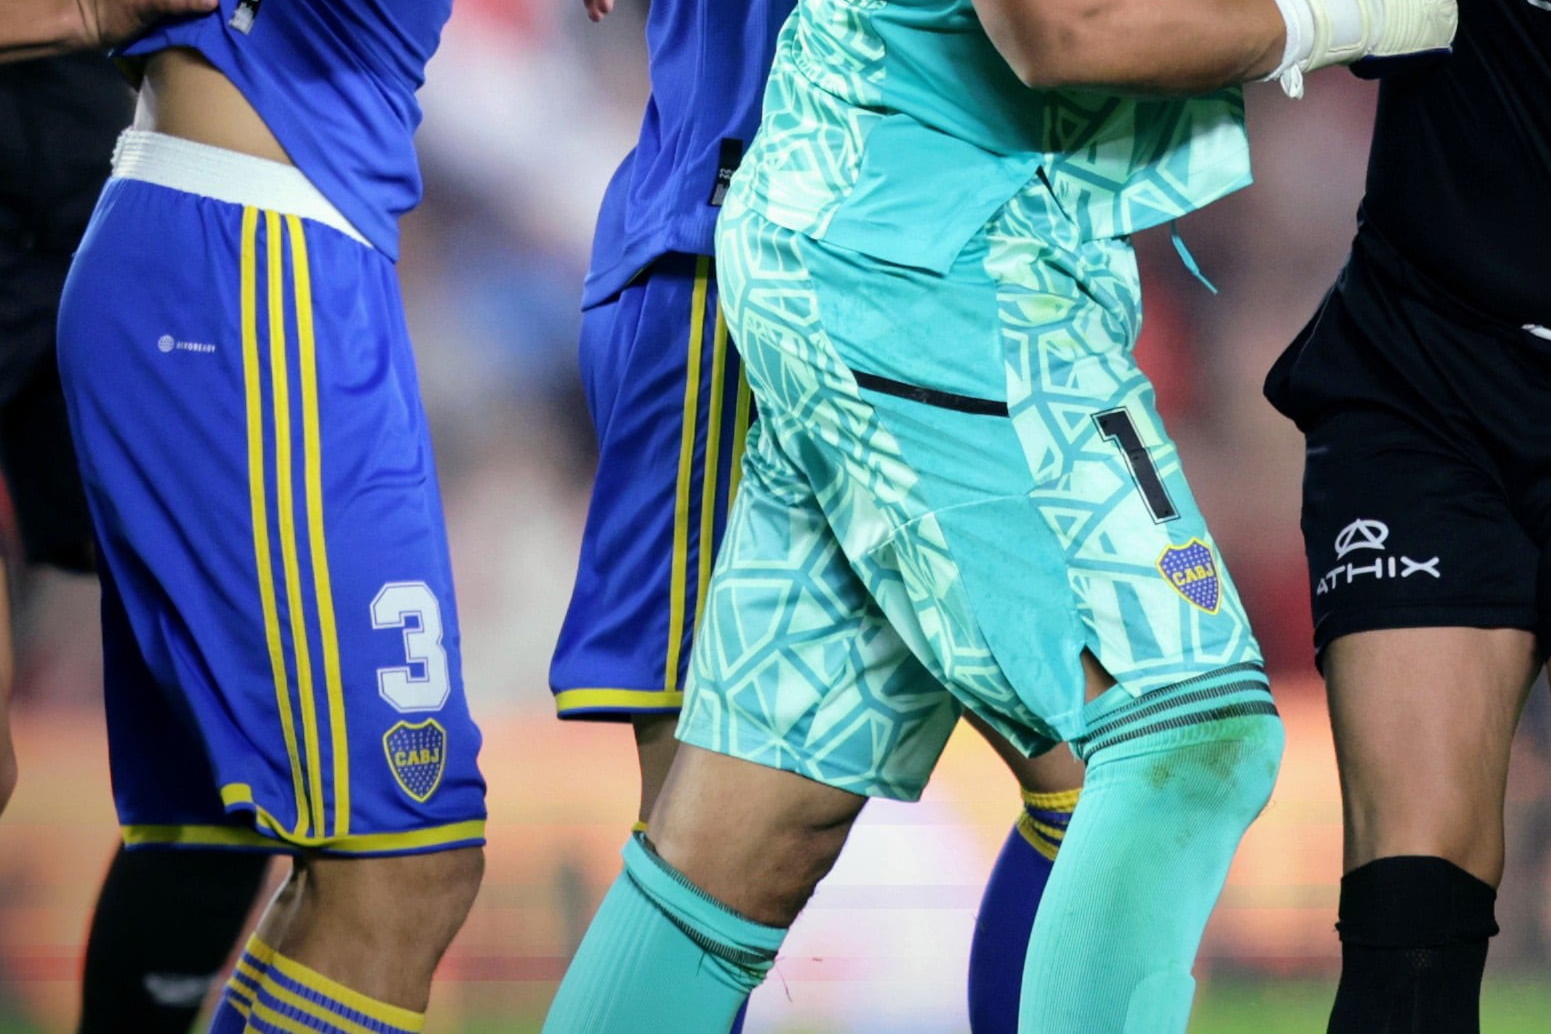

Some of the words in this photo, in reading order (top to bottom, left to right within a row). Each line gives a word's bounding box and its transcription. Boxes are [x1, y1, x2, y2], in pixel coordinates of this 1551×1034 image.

[1090, 406, 1181, 526] 1
[1171, 562, 1214, 587] CABJ
[1316, 555, 1441, 596] ATHIX
[369, 581, 451, 714] 3
[394, 746, 440, 767] CABJ
